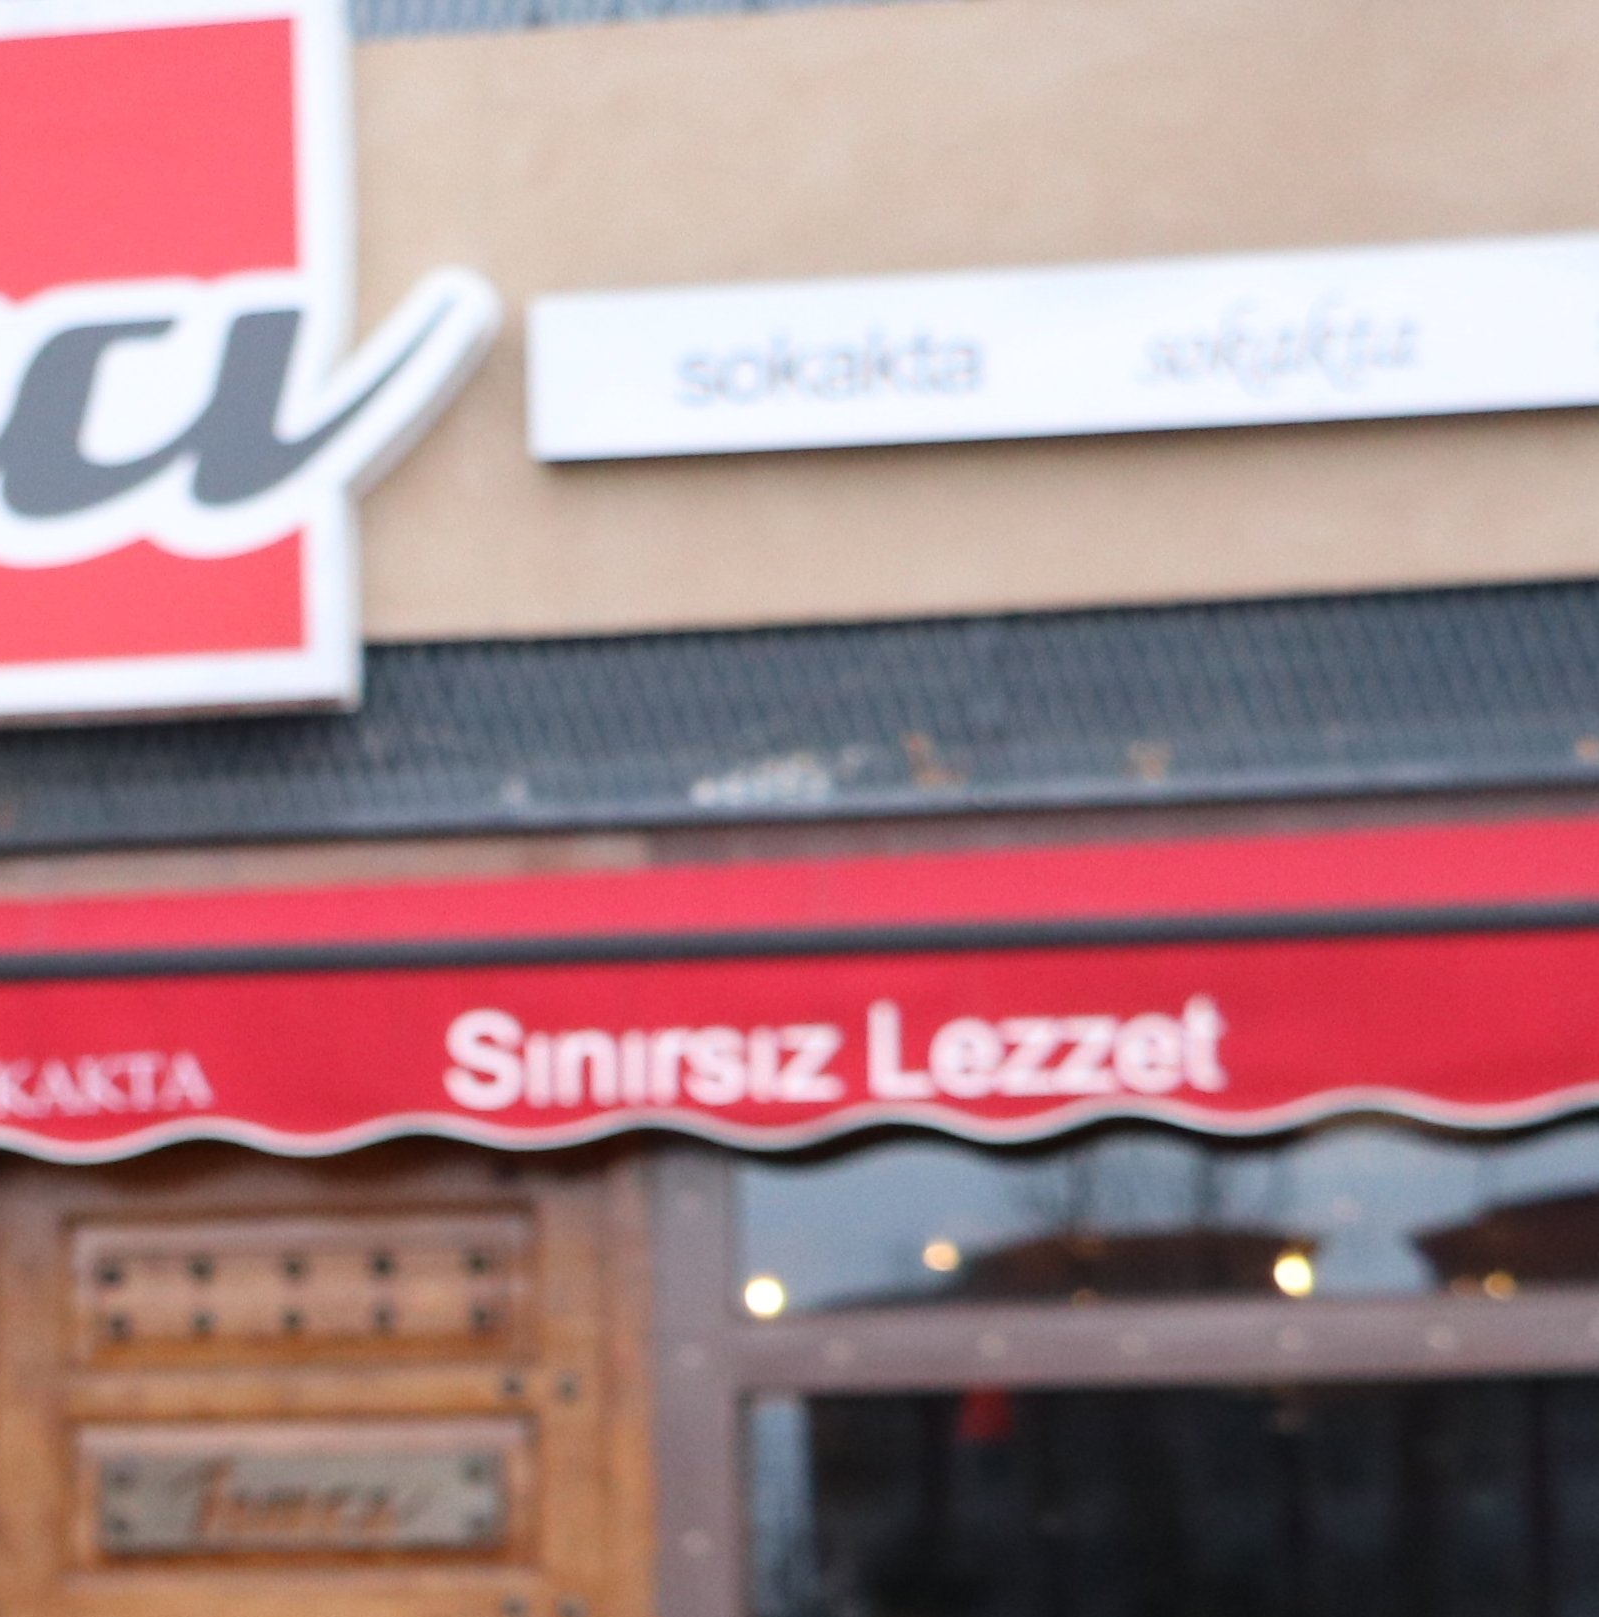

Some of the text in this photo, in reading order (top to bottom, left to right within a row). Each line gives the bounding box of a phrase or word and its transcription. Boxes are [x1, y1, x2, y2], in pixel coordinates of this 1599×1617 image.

[679, 323, 985, 405] sokakta
[442, 995, 1227, 1111] Sınırsız Lezzet
